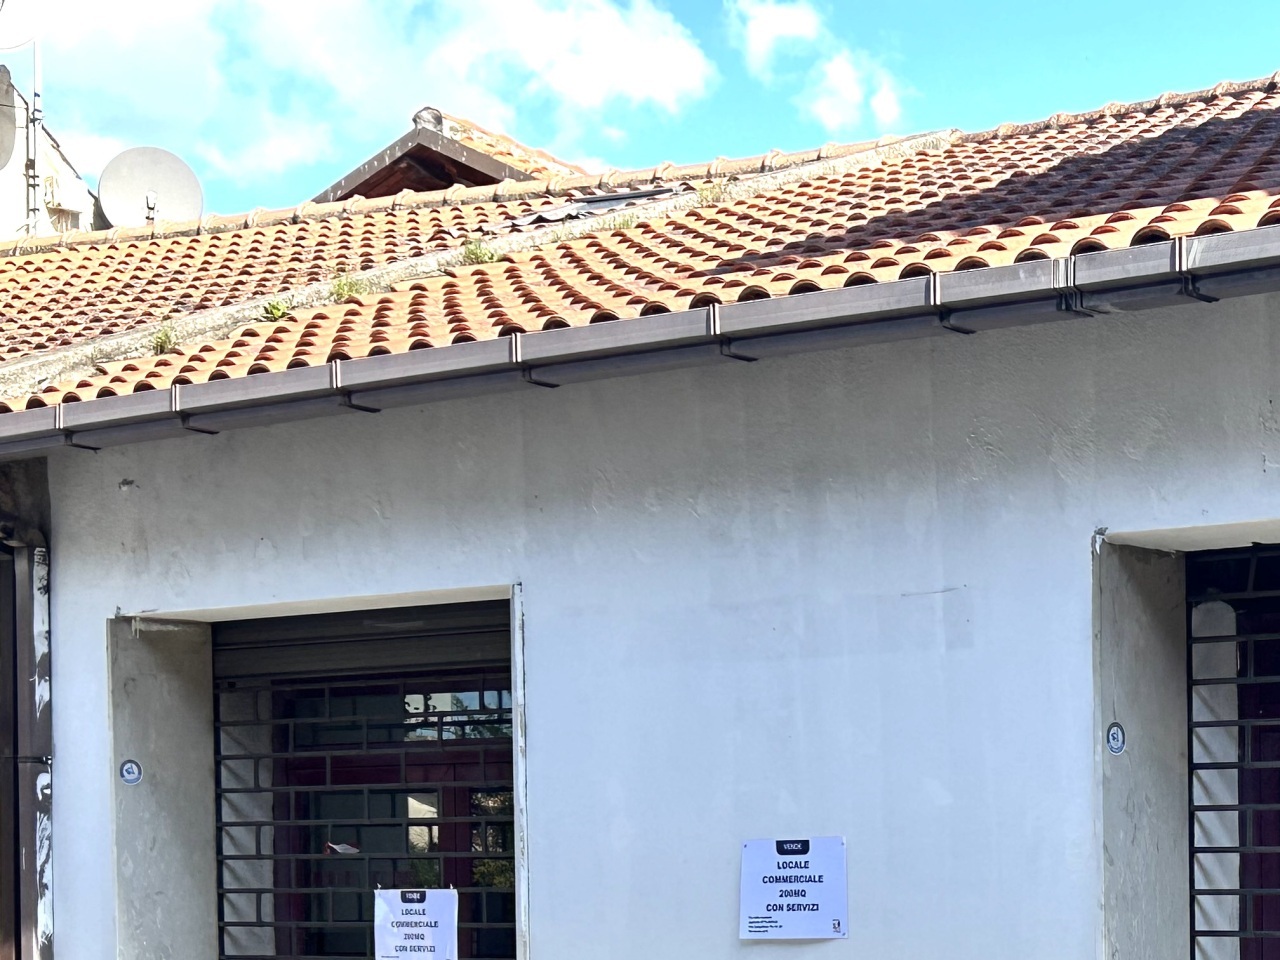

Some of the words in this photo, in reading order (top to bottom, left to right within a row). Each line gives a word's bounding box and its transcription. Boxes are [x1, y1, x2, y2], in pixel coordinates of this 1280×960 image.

[777, 861, 810, 870] LOCALE
[762, 874, 824, 884] COMMERCIALE
[401, 908, 426, 916] LOCALE
[766, 903, 784, 912] CON
[786, 903, 819, 912] SERVIZI
